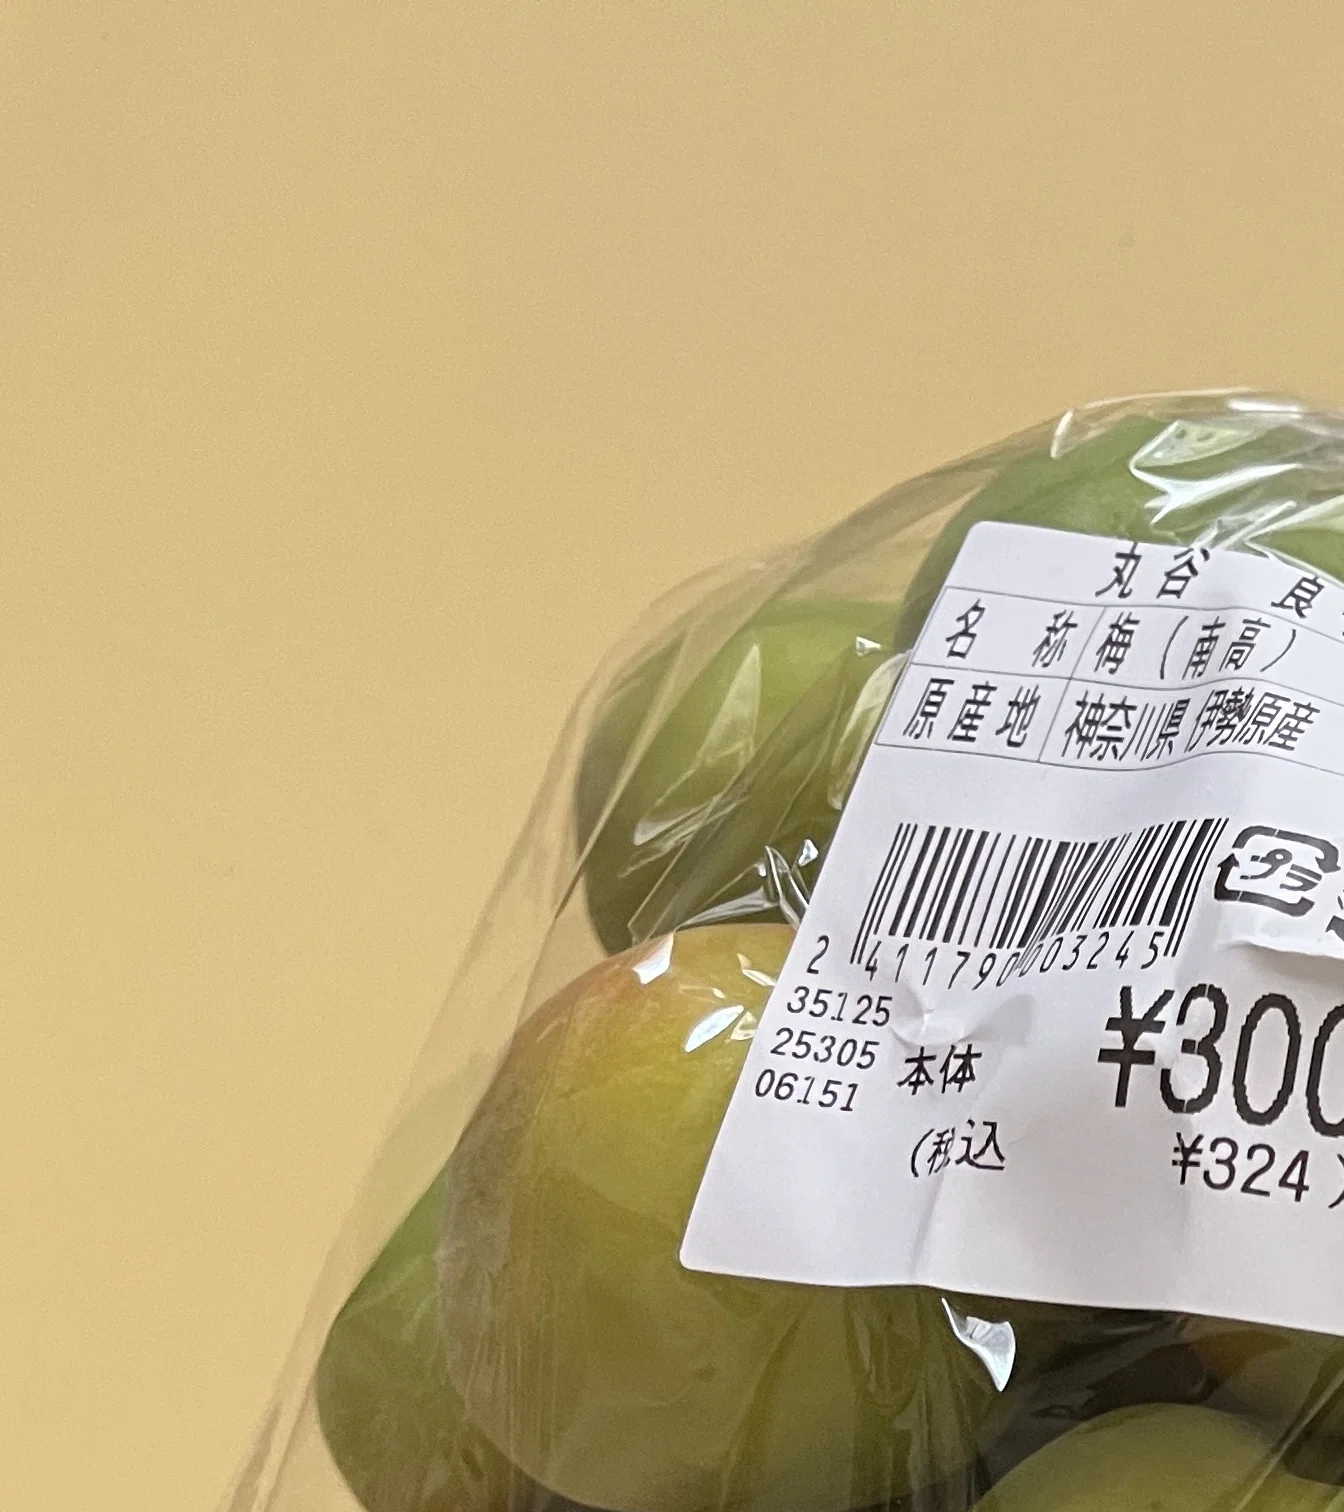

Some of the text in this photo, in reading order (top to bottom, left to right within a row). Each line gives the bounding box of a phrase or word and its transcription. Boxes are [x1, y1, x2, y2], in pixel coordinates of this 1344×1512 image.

[903, 677, 1321, 761] 原産地 神奈川県 伊勢原産
[786, 986, 893, 1027] 35125
[770, 1027, 880, 1070] 25305
[896, 1043, 982, 1095] 本体
[754, 1069, 859, 1112] 06151
